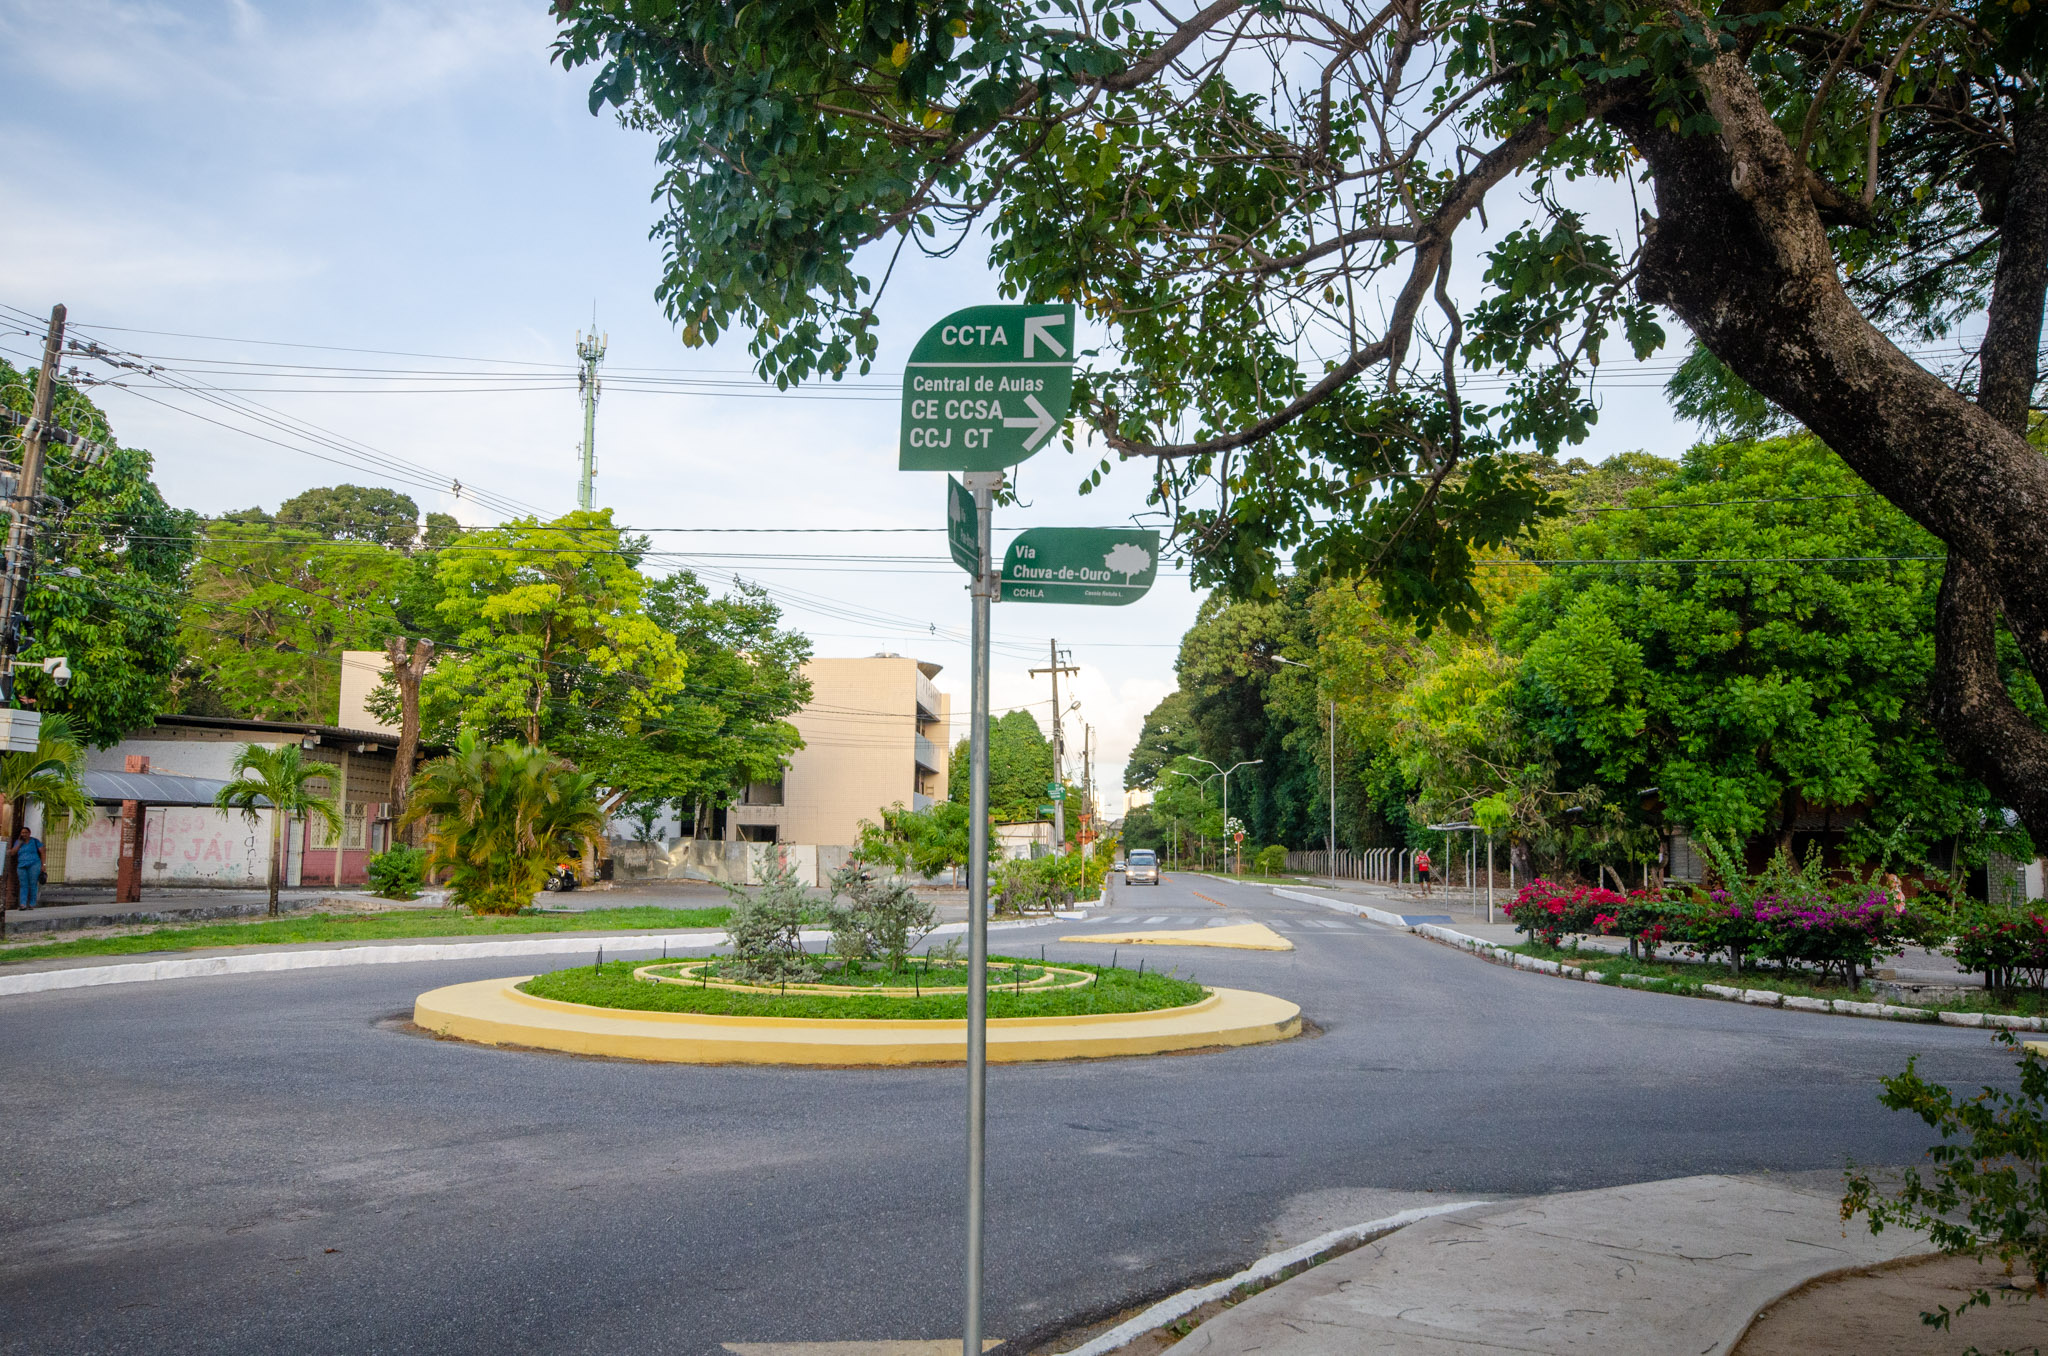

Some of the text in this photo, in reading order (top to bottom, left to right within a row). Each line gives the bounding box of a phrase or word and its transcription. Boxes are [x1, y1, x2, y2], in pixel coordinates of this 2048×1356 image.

[941, 325, 1008, 346] CCTA
[913, 376, 1044, 392] Central de Aulas
[911, 399, 1003, 420] CE CCSA
[909, 428, 993, 448] CCJ CT
[1015, 545, 1036, 559] Via
[1013, 564, 1111, 581] Chuva-de-Ouro
[1013, 588, 1044, 598] CCHLA
[80, 837, 176, 859] INTNO
